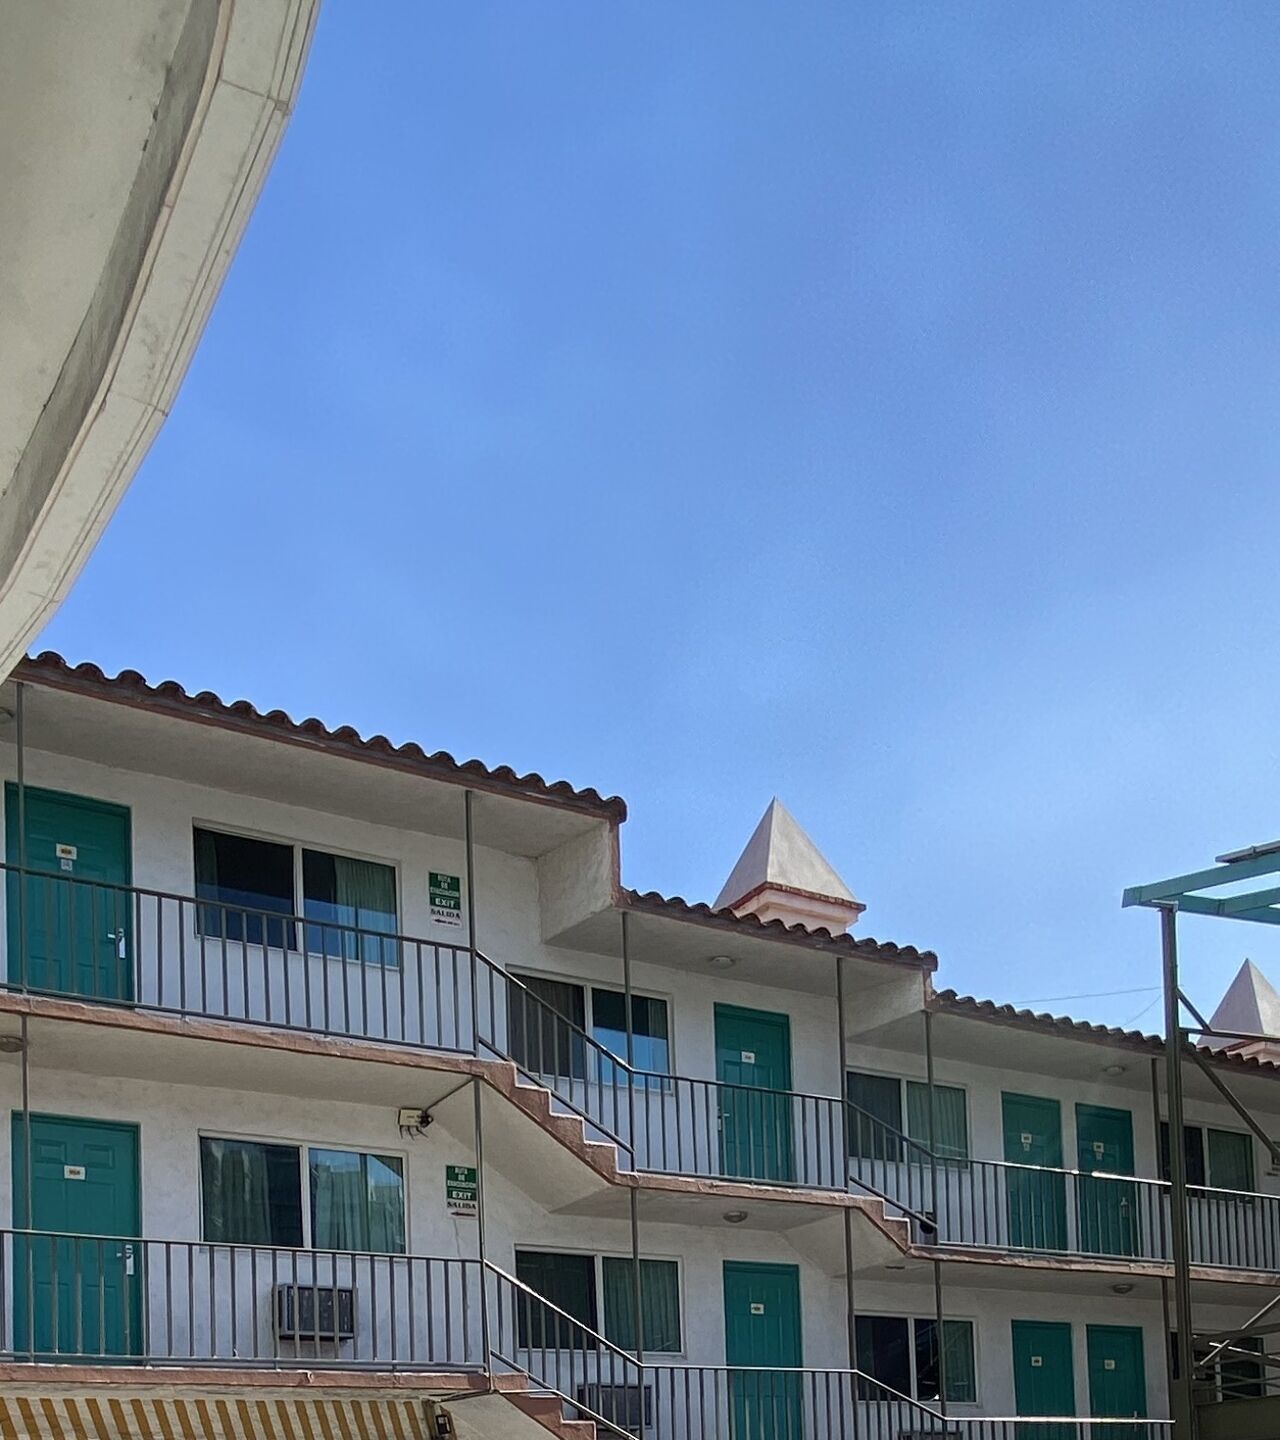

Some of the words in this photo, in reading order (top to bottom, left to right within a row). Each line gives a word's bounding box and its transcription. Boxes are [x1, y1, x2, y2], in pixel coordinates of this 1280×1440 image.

[435, 898, 455, 907] EXIT
[430, 909, 461, 919] SALIDA
[452, 1191, 472, 1200] EXIT
[447, 1201, 477, 1210] SALIDA
